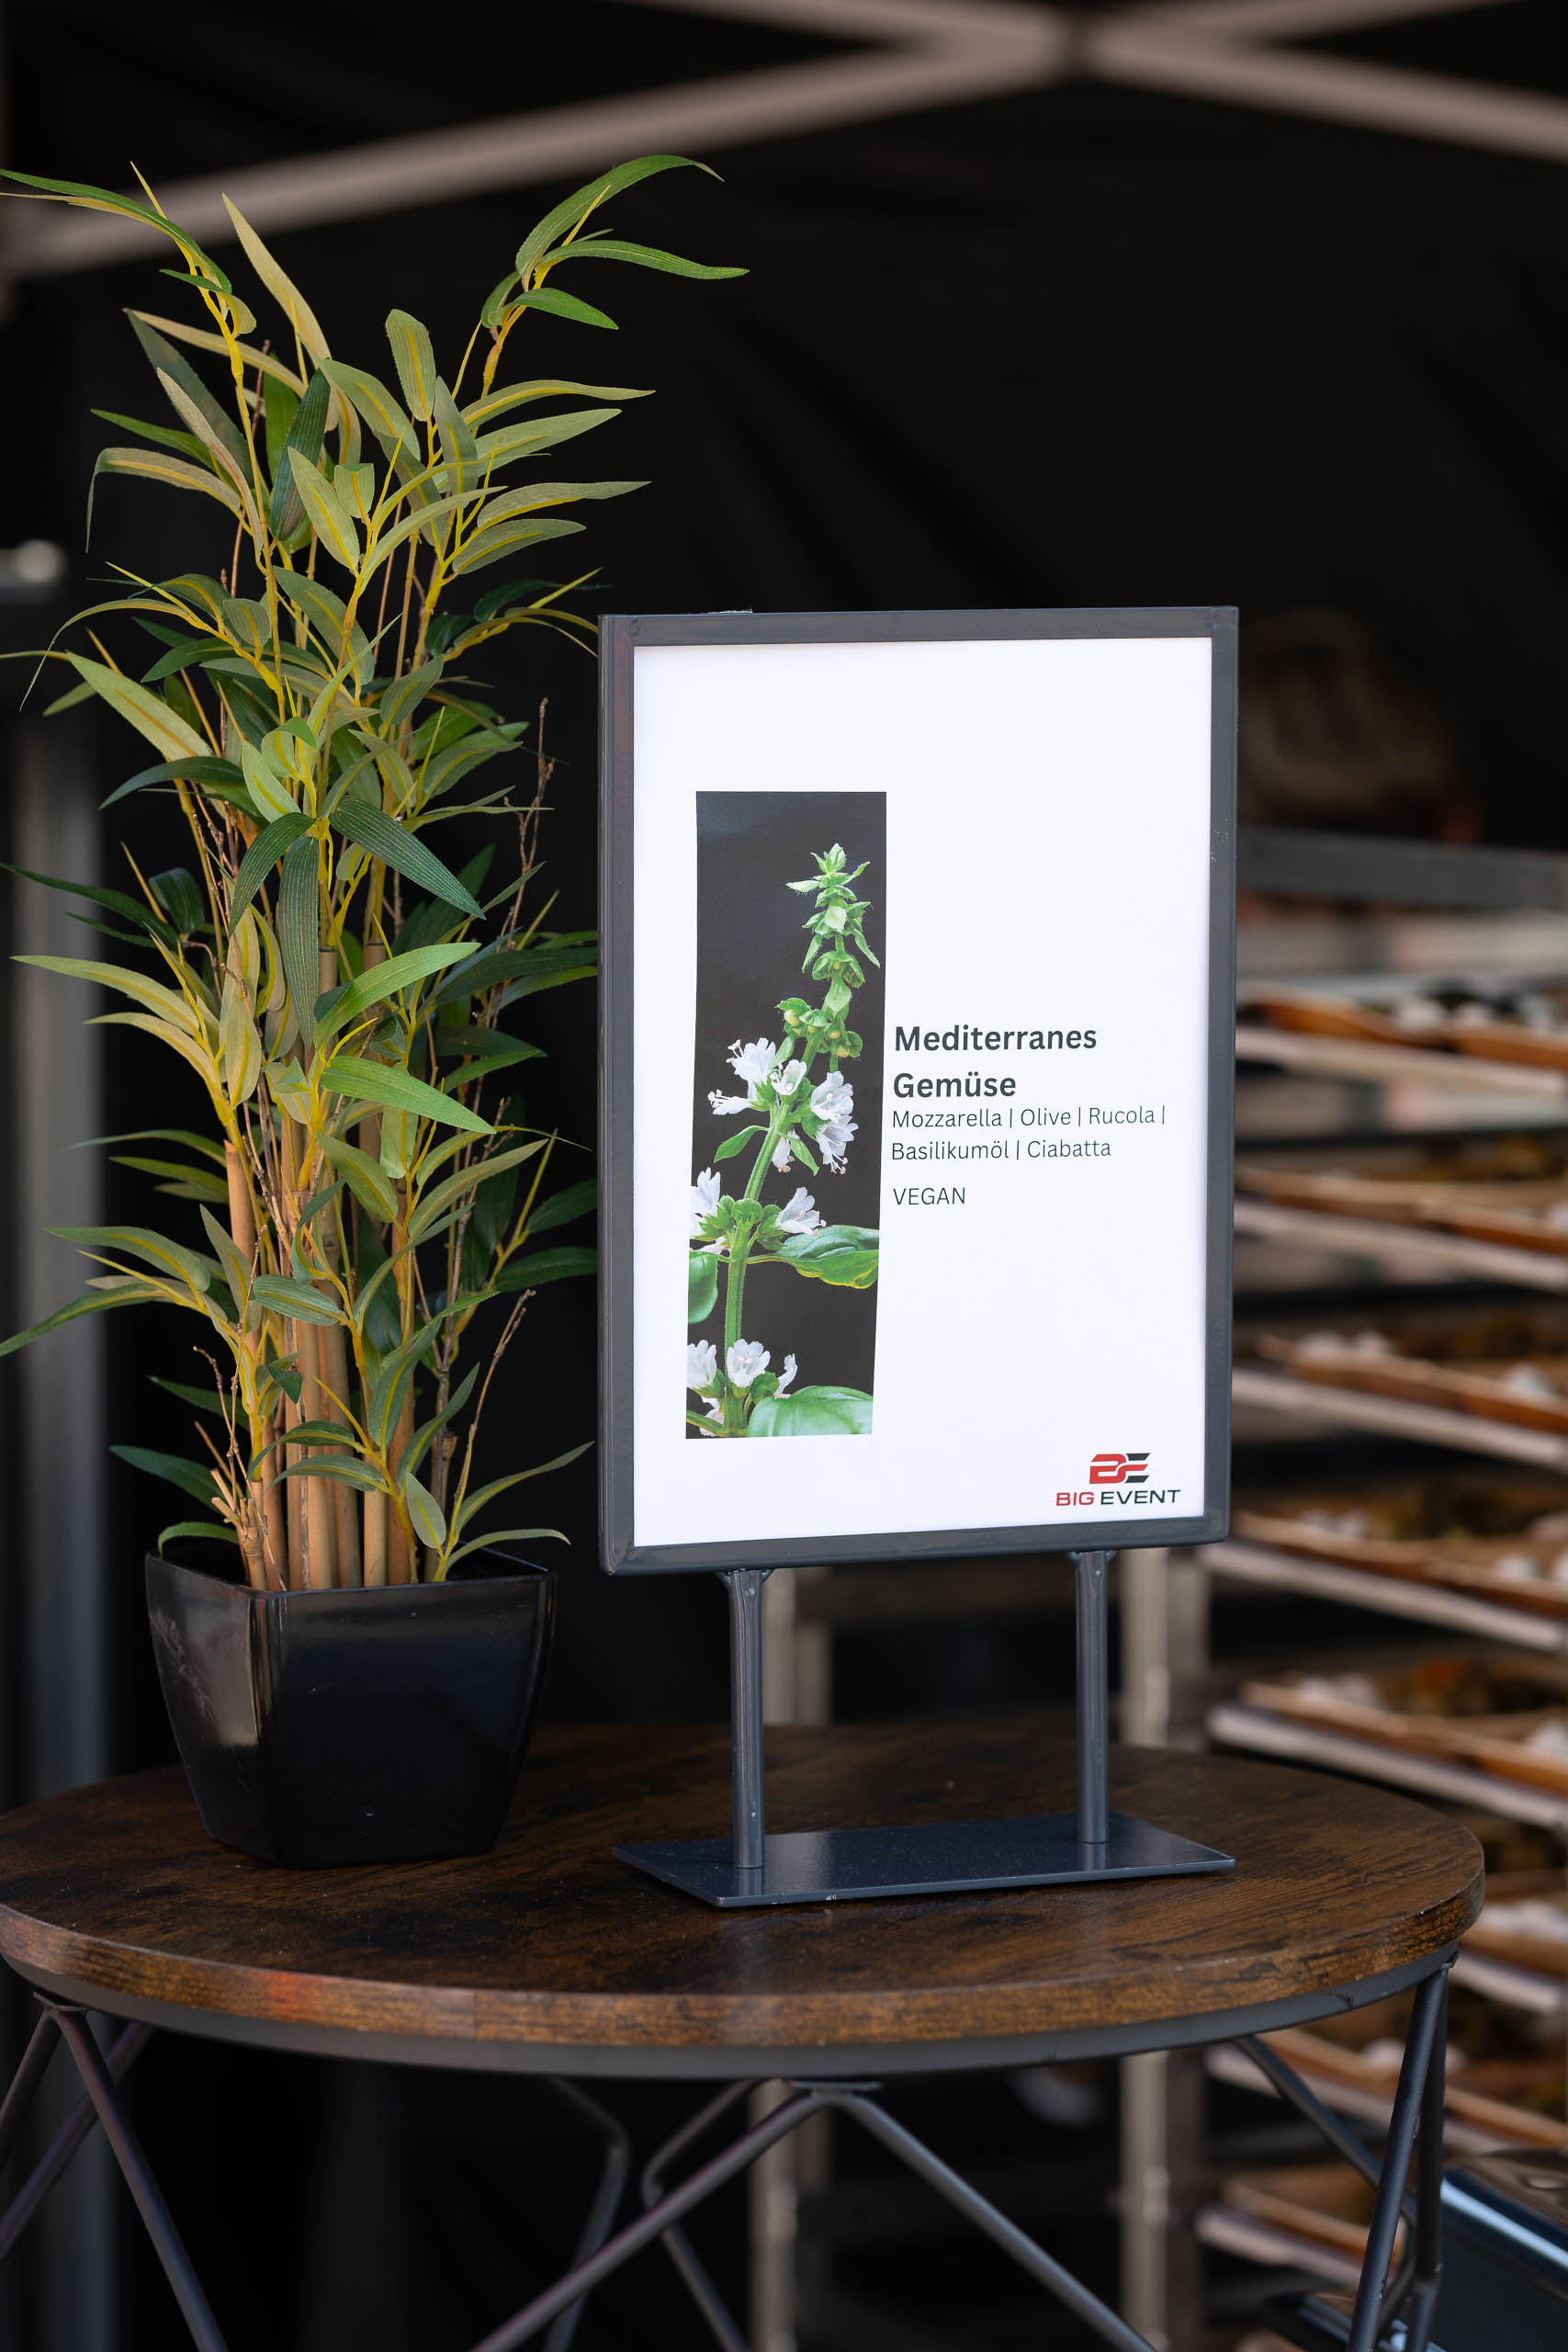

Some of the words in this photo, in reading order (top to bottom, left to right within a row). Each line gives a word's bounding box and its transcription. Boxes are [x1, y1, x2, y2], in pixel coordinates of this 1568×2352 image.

[895, 1024, 1097, 1052] Mediterranes
[893, 1070, 1017, 1099] Gemüse
[892, 1108, 1003, 1128] Mozzarella
[1021, 1108, 1071, 1126] Olive
[1089, 1105, 1156, 1125] Rucola
[892, 1140, 1010, 1160] Basilikumöl
[1027, 1139, 1111, 1159] Ciabatta
[892, 1187, 966, 1205] VEGAN
[1055, 1491, 1095, 1507] BIG
[1100, 1489, 1182, 1506] EVENT
